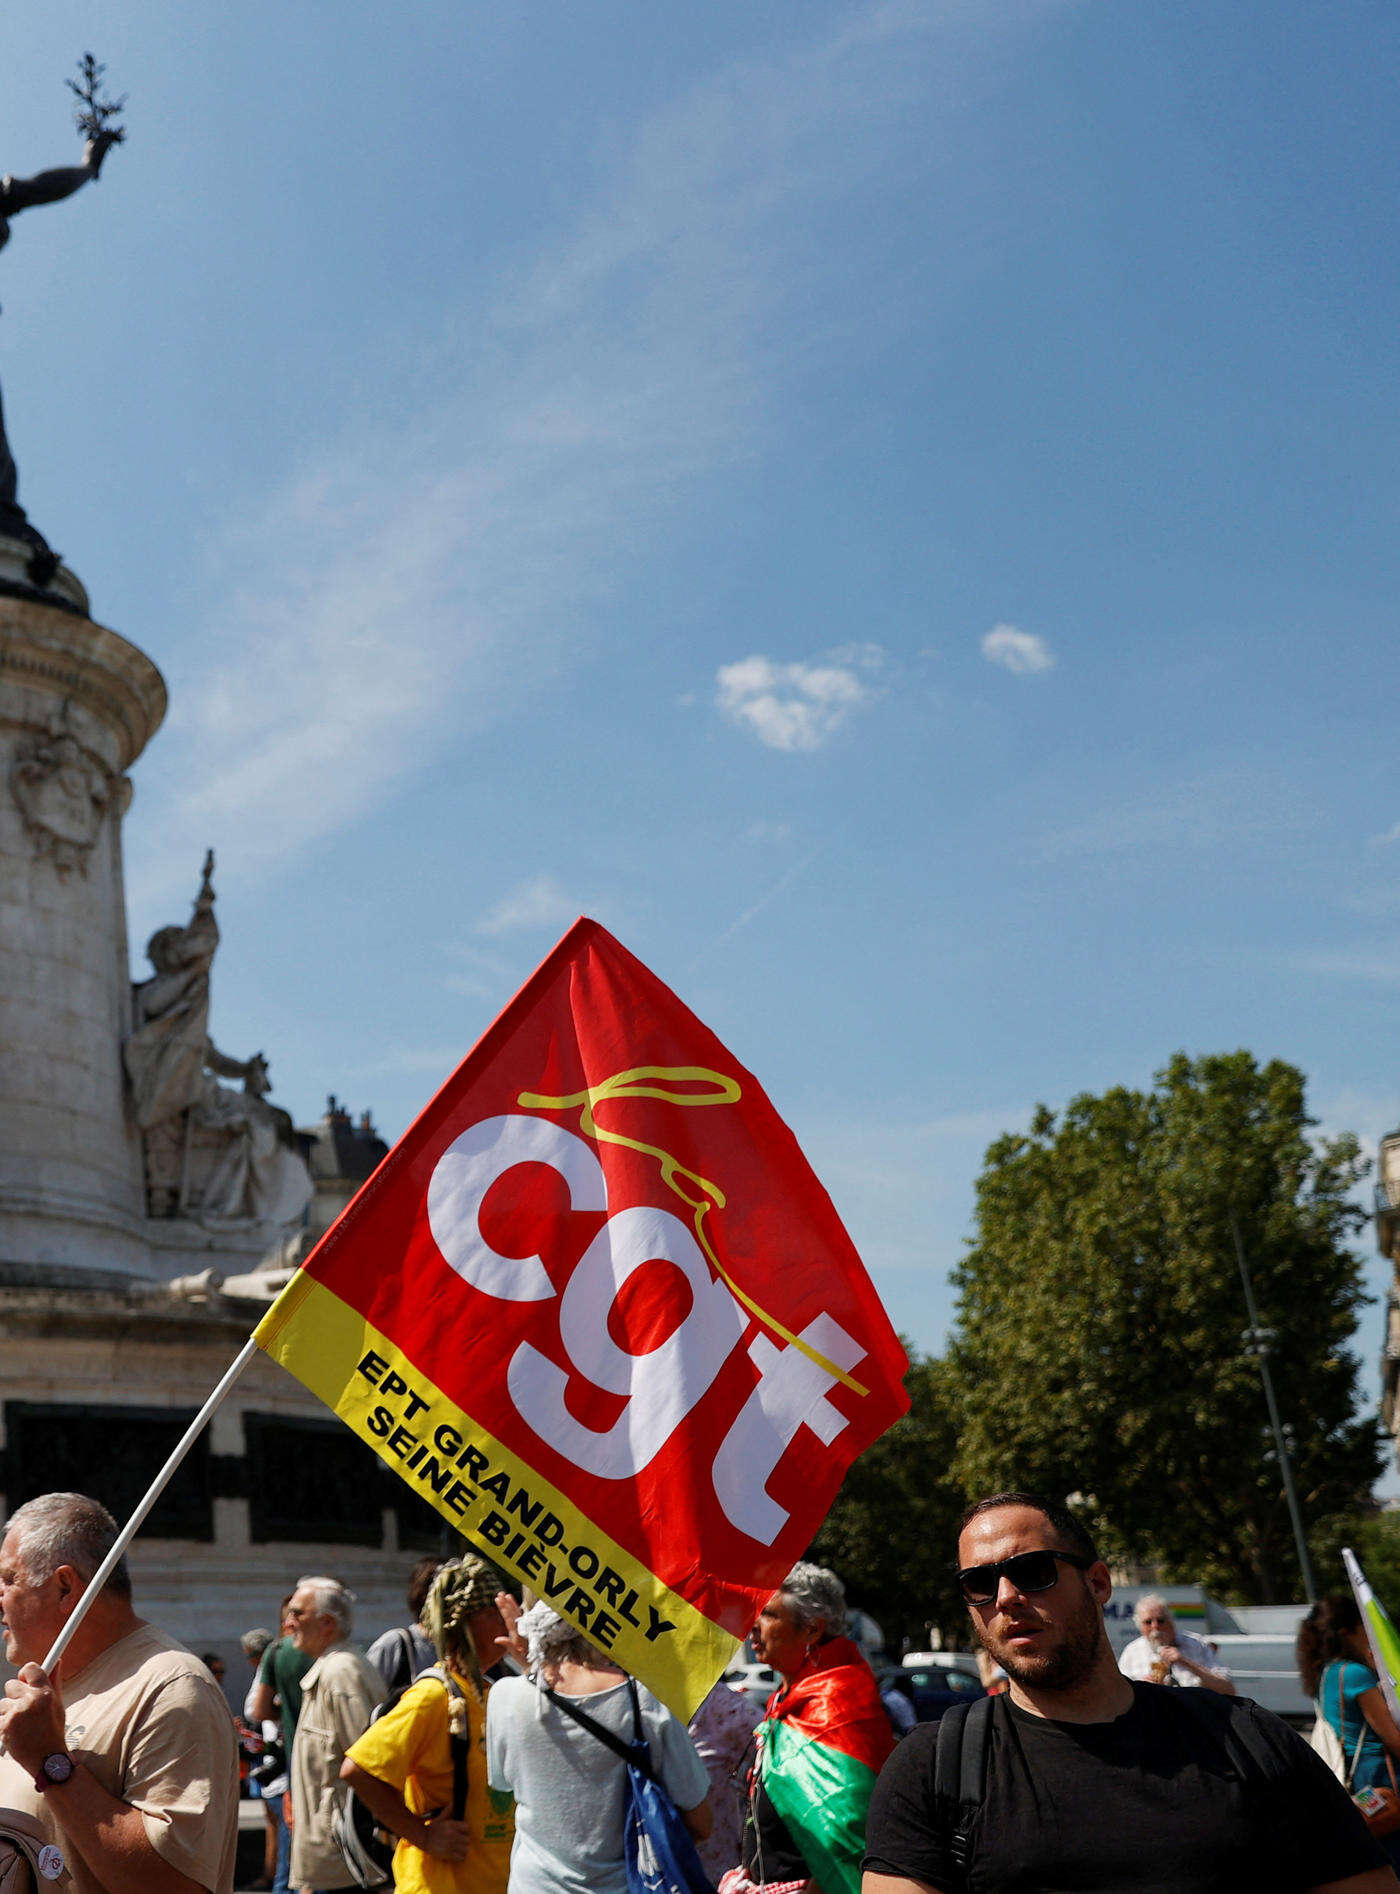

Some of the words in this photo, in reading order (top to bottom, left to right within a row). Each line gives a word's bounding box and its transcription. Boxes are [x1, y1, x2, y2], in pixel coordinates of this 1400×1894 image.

[427, 1113, 868, 1548] cgt
[357, 1349, 431, 1422] EPT
[433, 1423, 677, 1642] GRAND-ORLY
[366, 1405, 477, 1517] SEINE
[477, 1510, 622, 1650] BIÈVRE
